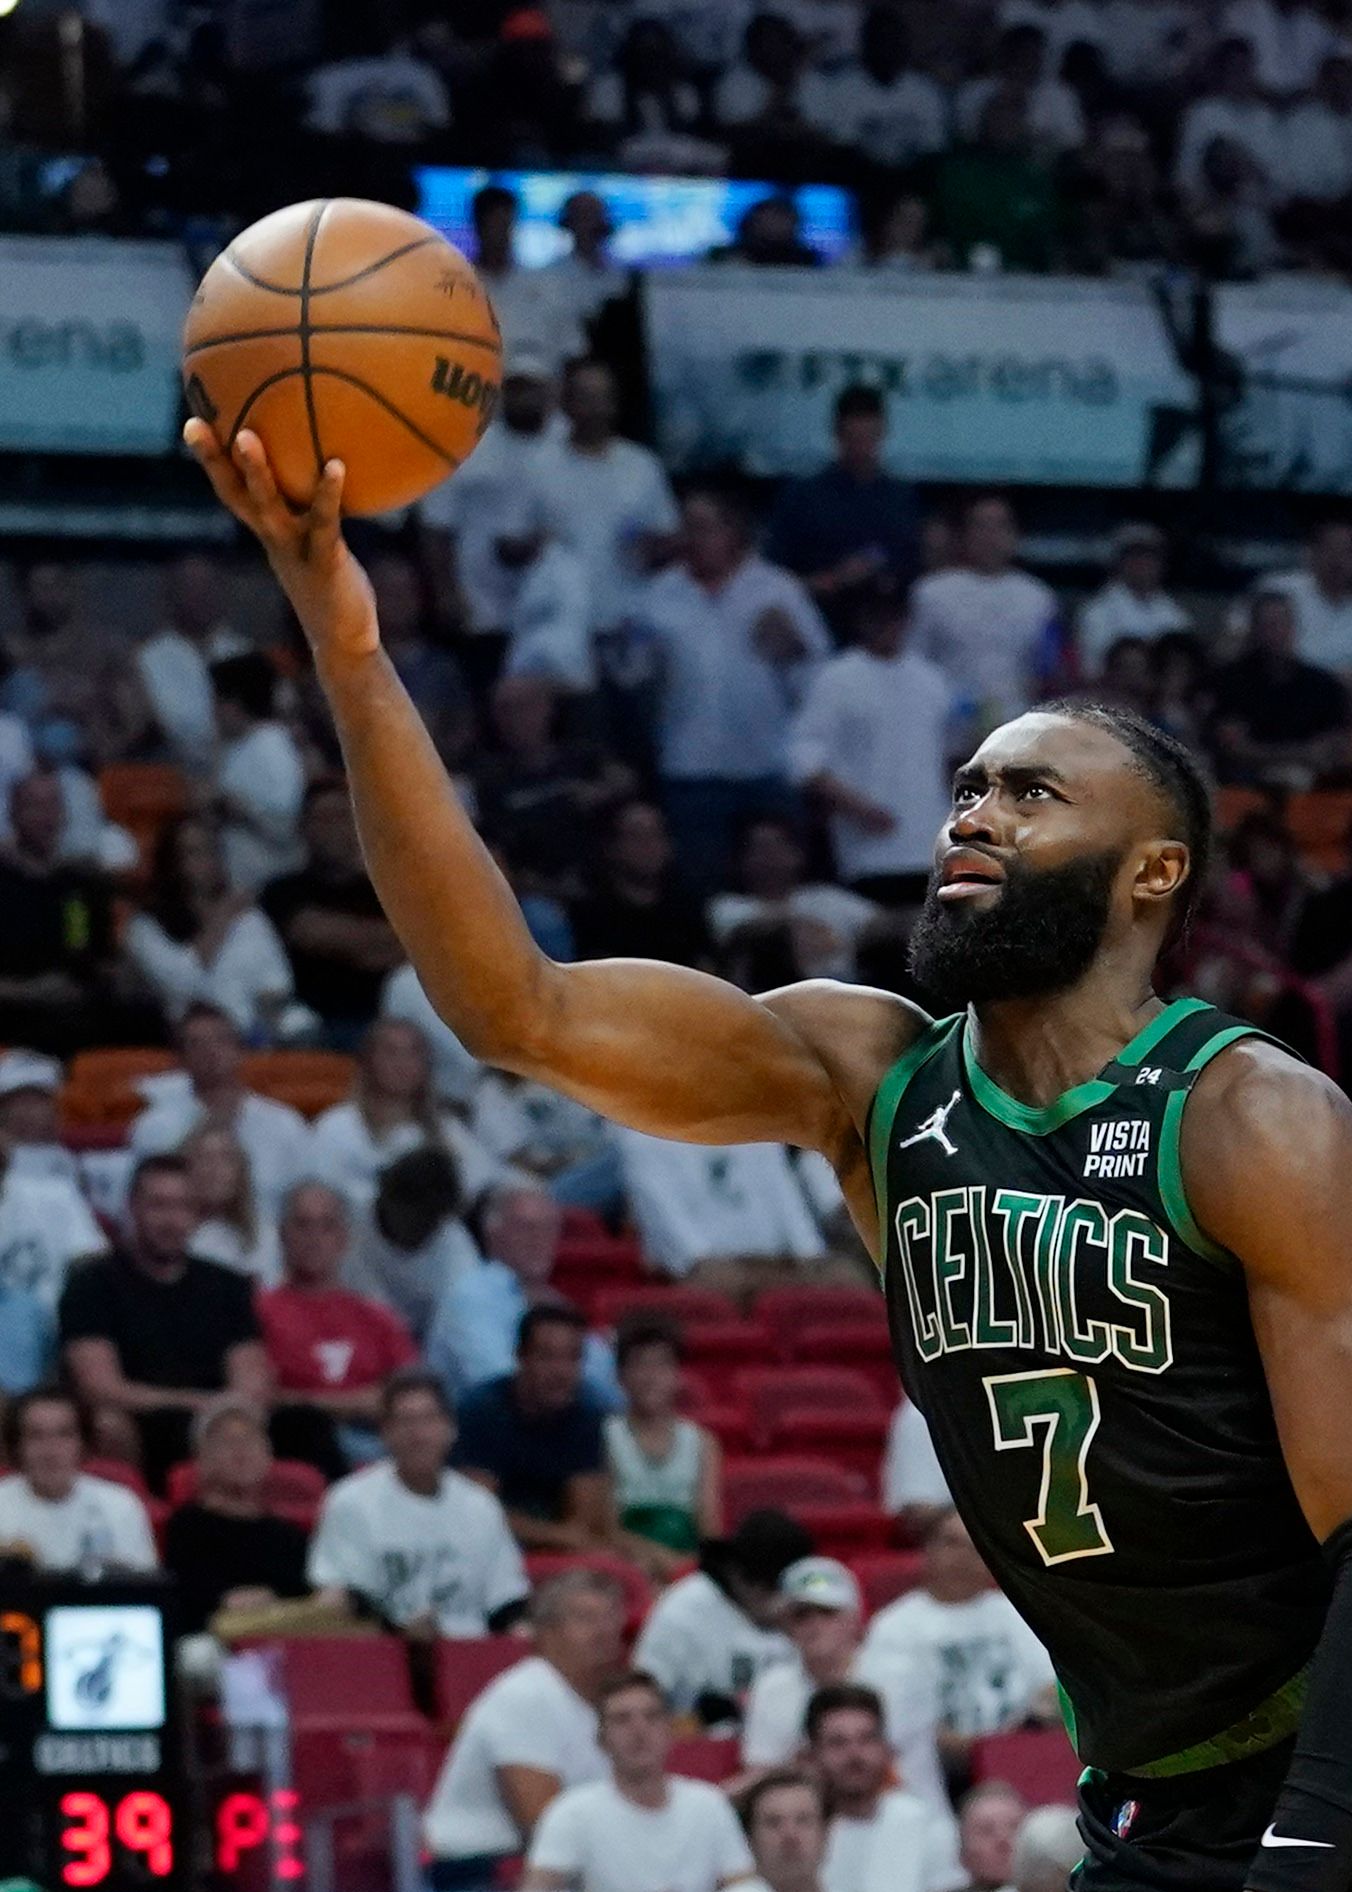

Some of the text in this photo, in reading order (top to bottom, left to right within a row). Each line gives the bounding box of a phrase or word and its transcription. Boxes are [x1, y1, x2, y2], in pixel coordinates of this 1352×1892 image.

[1135, 1067, 1163, 1086] 24
[1083, 1152, 1149, 1178] PRINT
[1090, 1120, 1151, 1153] VISTA
[895, 1186, 1174, 1375] CELTICS
[982, 1367, 1115, 1567] 7
[59, 1792, 174, 1888] 39
